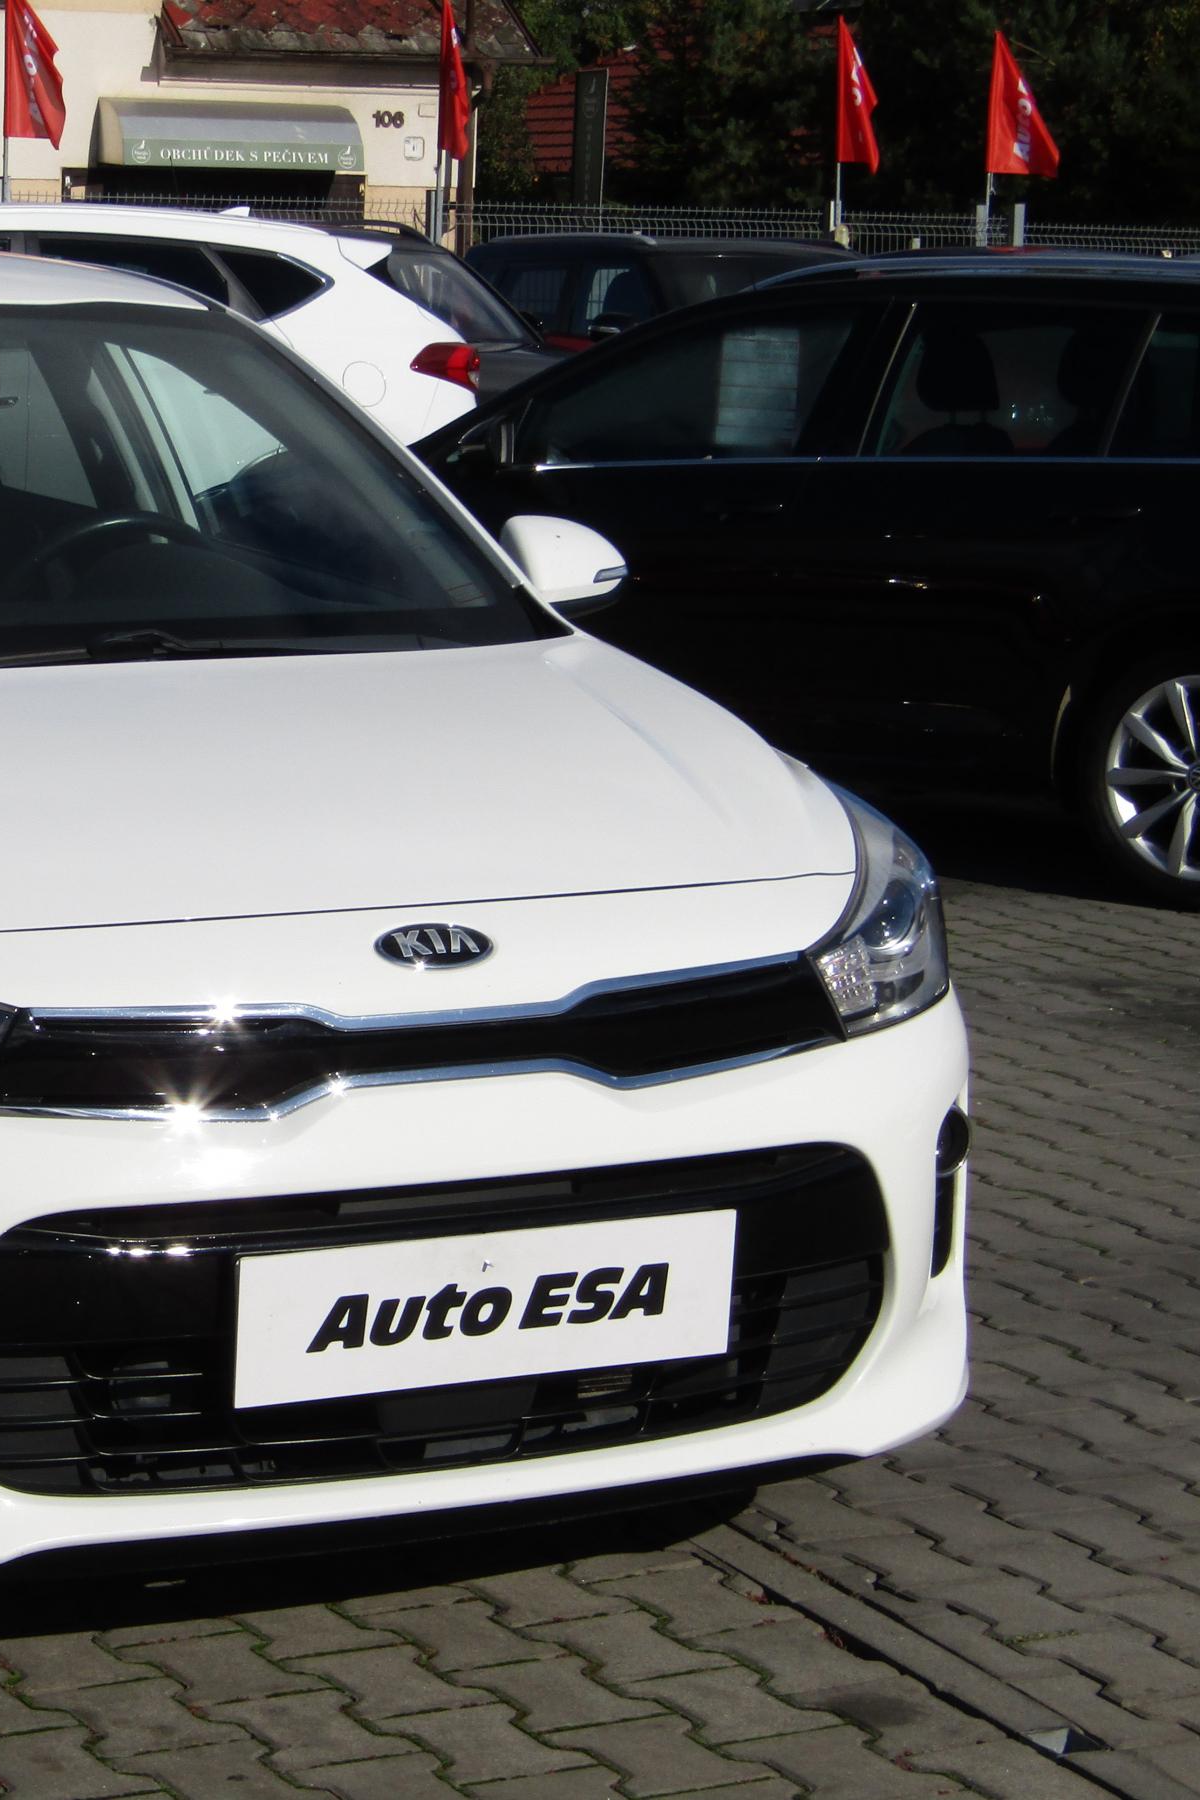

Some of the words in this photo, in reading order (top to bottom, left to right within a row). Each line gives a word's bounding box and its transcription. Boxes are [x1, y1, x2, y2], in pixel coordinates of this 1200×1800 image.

[372, 110, 405, 129] 106
[160, 146, 245, 162] OBCHŮDEK
[249, 151, 258, 162] S
[263, 149, 328, 164] PEČIVEM
[391, 927, 481, 958] KIA
[306, 1283, 513, 1354] Auto
[518, 1262, 670, 1331] ESA
